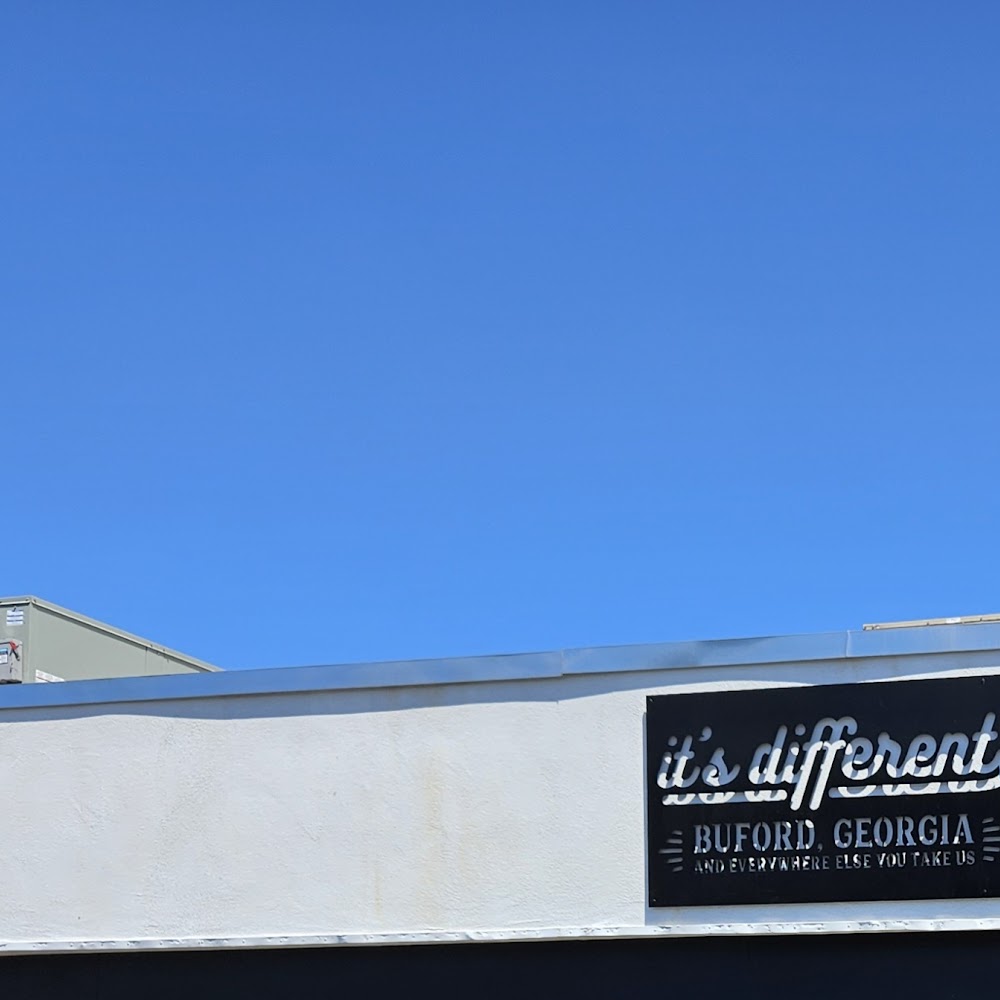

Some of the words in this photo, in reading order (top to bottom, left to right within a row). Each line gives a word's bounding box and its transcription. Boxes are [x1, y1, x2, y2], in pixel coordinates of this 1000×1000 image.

[657, 726, 741, 789] it's
[693, 819, 824, 854] BUFORD,
[833, 813, 975, 849] GEORGIA
[694, 857, 726, 875] AND
[729, 854, 831, 873] EVERYWHERE
[835, 853, 872, 870] ELSE
[877, 852, 906, 868] YOU
[910, 850, 952, 867] TAKE
[956, 849, 976, 866] US
